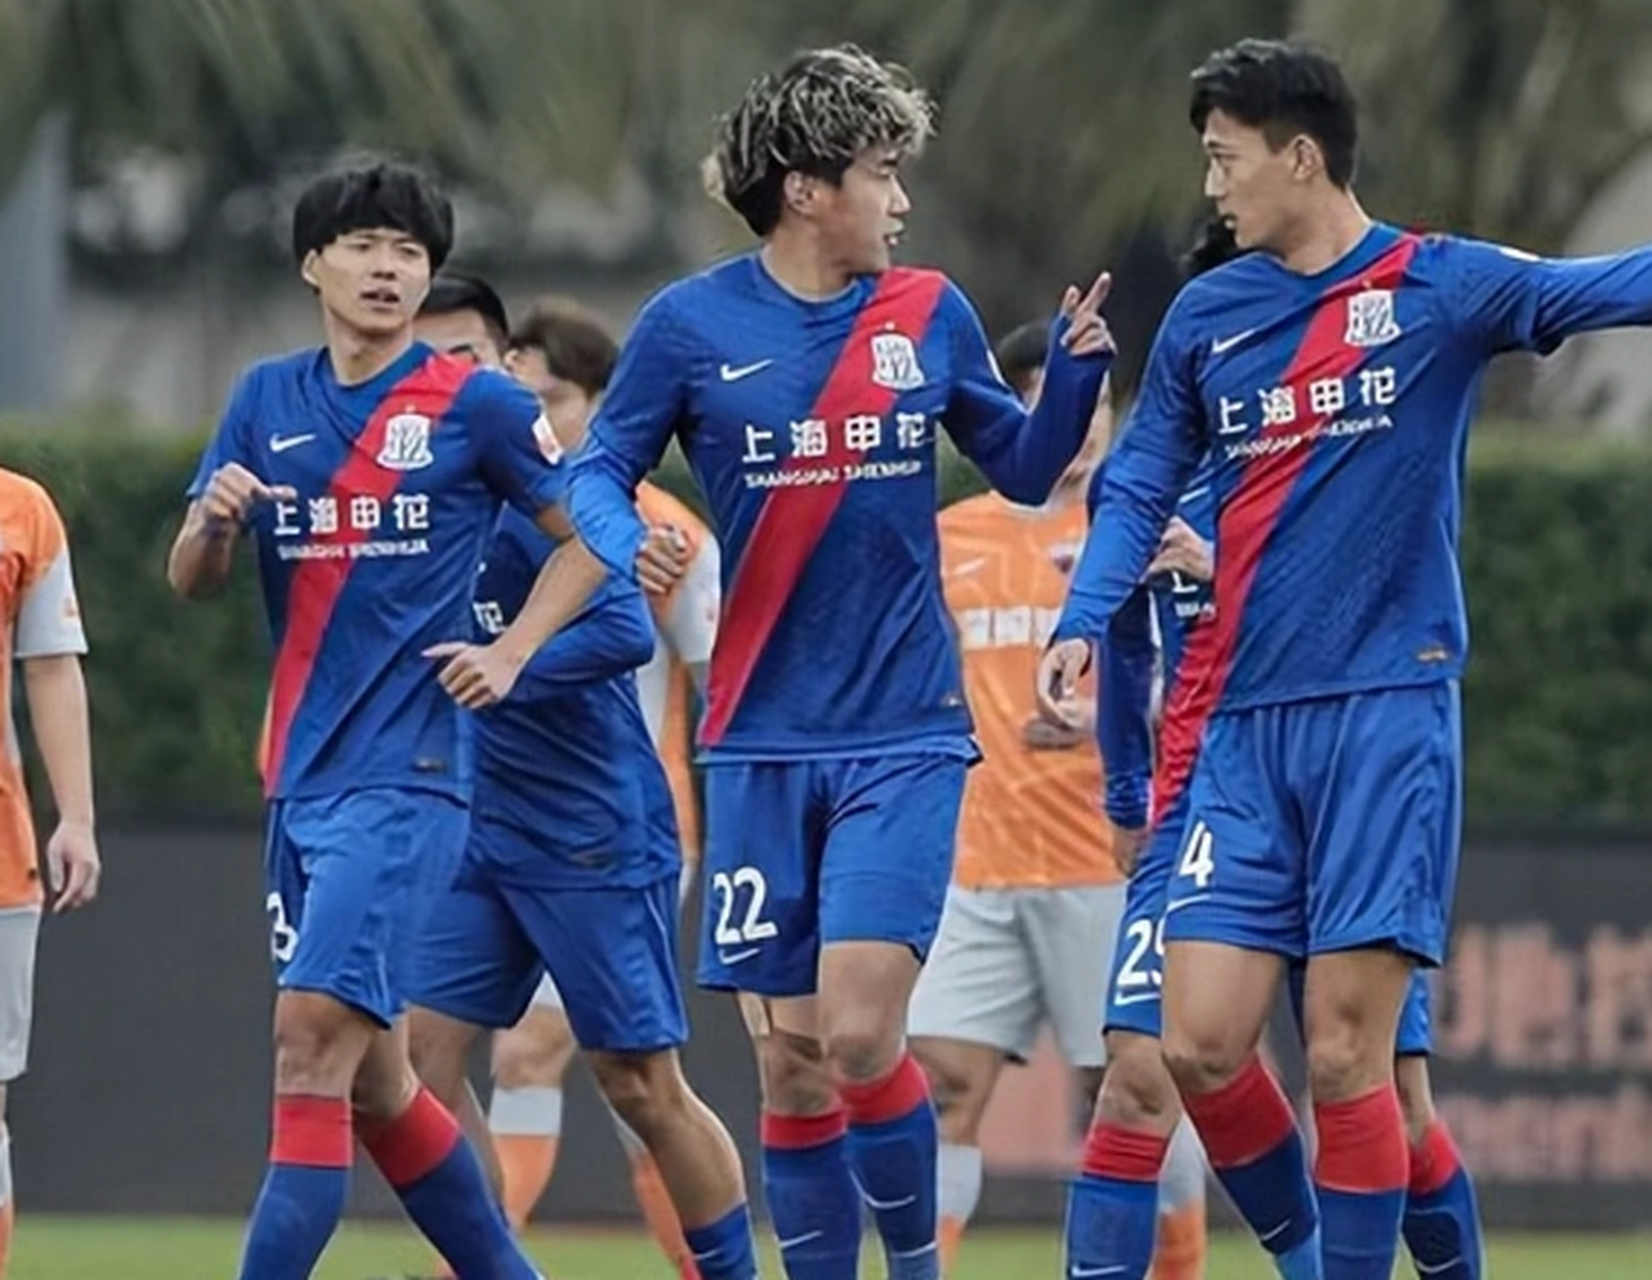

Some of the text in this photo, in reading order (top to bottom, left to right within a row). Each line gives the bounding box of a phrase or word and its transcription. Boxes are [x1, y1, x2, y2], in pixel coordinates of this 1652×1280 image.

[1218, 366, 1395, 434] 上海申花
[742, 412, 926, 464] 上海申花
[274, 493, 430, 536] 上海申花
[1179, 821, 1214, 888] 4
[713, 866, 779, 945] 22
